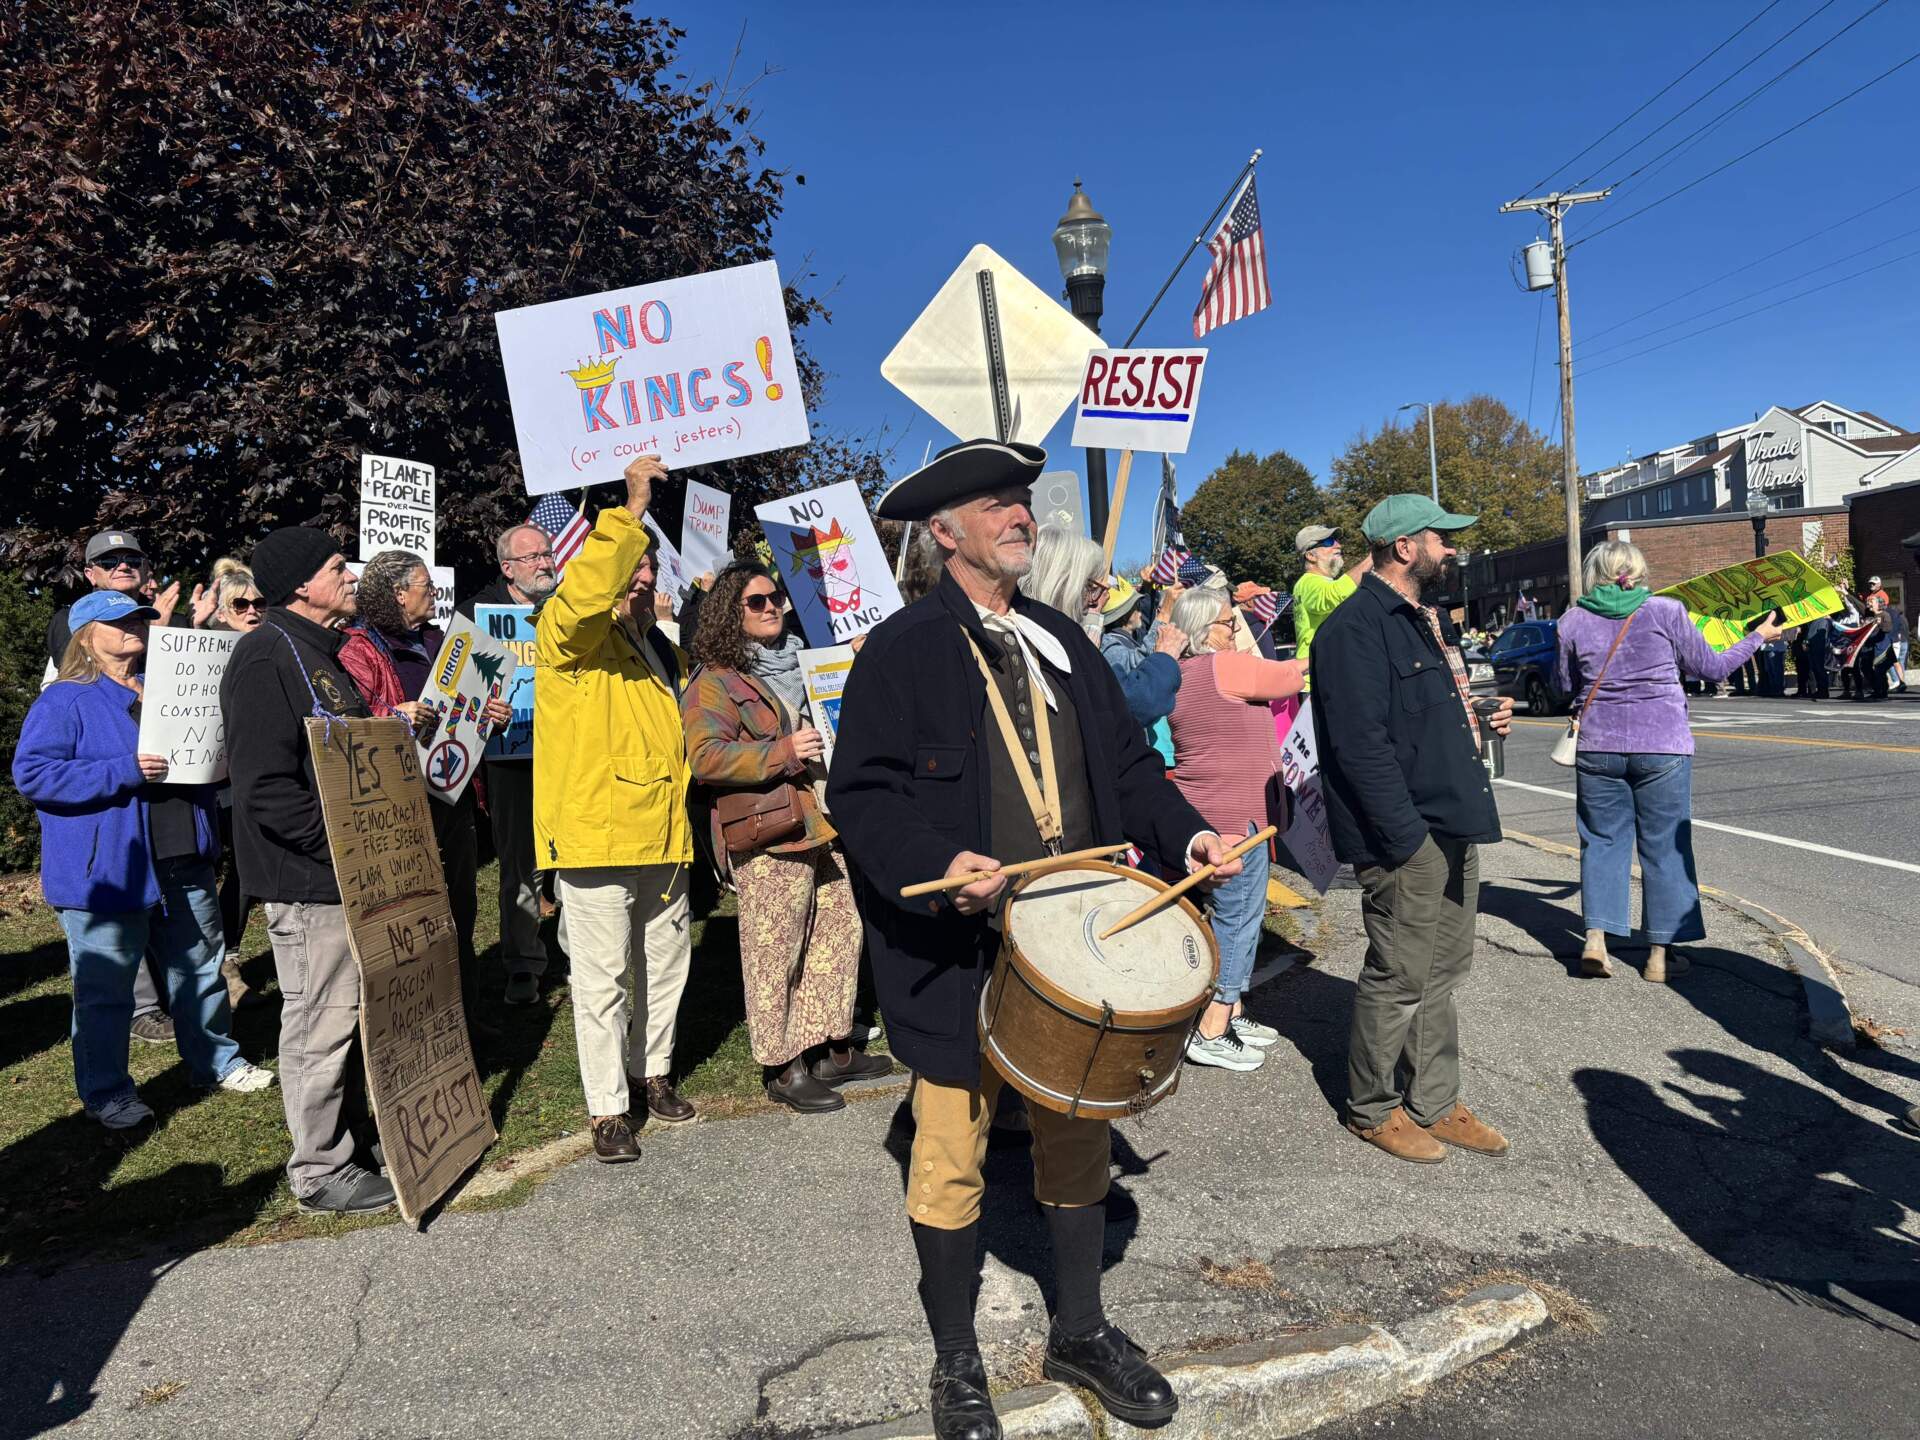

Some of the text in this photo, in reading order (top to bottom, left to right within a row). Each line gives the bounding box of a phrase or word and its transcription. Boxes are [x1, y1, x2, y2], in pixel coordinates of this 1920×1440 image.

[593, 300, 672, 355] NO
[581, 336, 783, 433] KINGS!
[1082, 355, 1203, 409] RESIST
[571, 417, 742, 472] (or court jesters)
[1747, 430, 1800, 461] Trade
[371, 459, 432, 487] PLANET
[1747, 462, 1807, 489] Winds
[373, 480, 431, 505] PEOPLE
[387, 502, 408, 511] OVER
[693, 493, 724, 519] DUMP
[367, 509, 431, 534] PROFITS
[789, 499, 824, 524] NO
[368, 529, 428, 551] POWER
[689, 515, 722, 538] TRUMP
[488, 613, 516, 640] NO
[827, 606, 882, 636] KING
[160, 633, 233, 653] SUPREME
[175, 662, 195, 676] DO
[440, 638, 465, 686] DIRIGO
[1293, 731, 1310, 759] The
[333, 732, 381, 800] YES
[352, 800, 426, 833] DEMOCRACY!
[363, 835, 389, 860] FREE
[387, 921, 414, 968] NO
[1186, 938, 1197, 966] EVANS
[388, 962, 435, 1009] FASCISM
[392, 992, 435, 1040] RACISM
[396, 1069, 485, 1177] RESIST!
